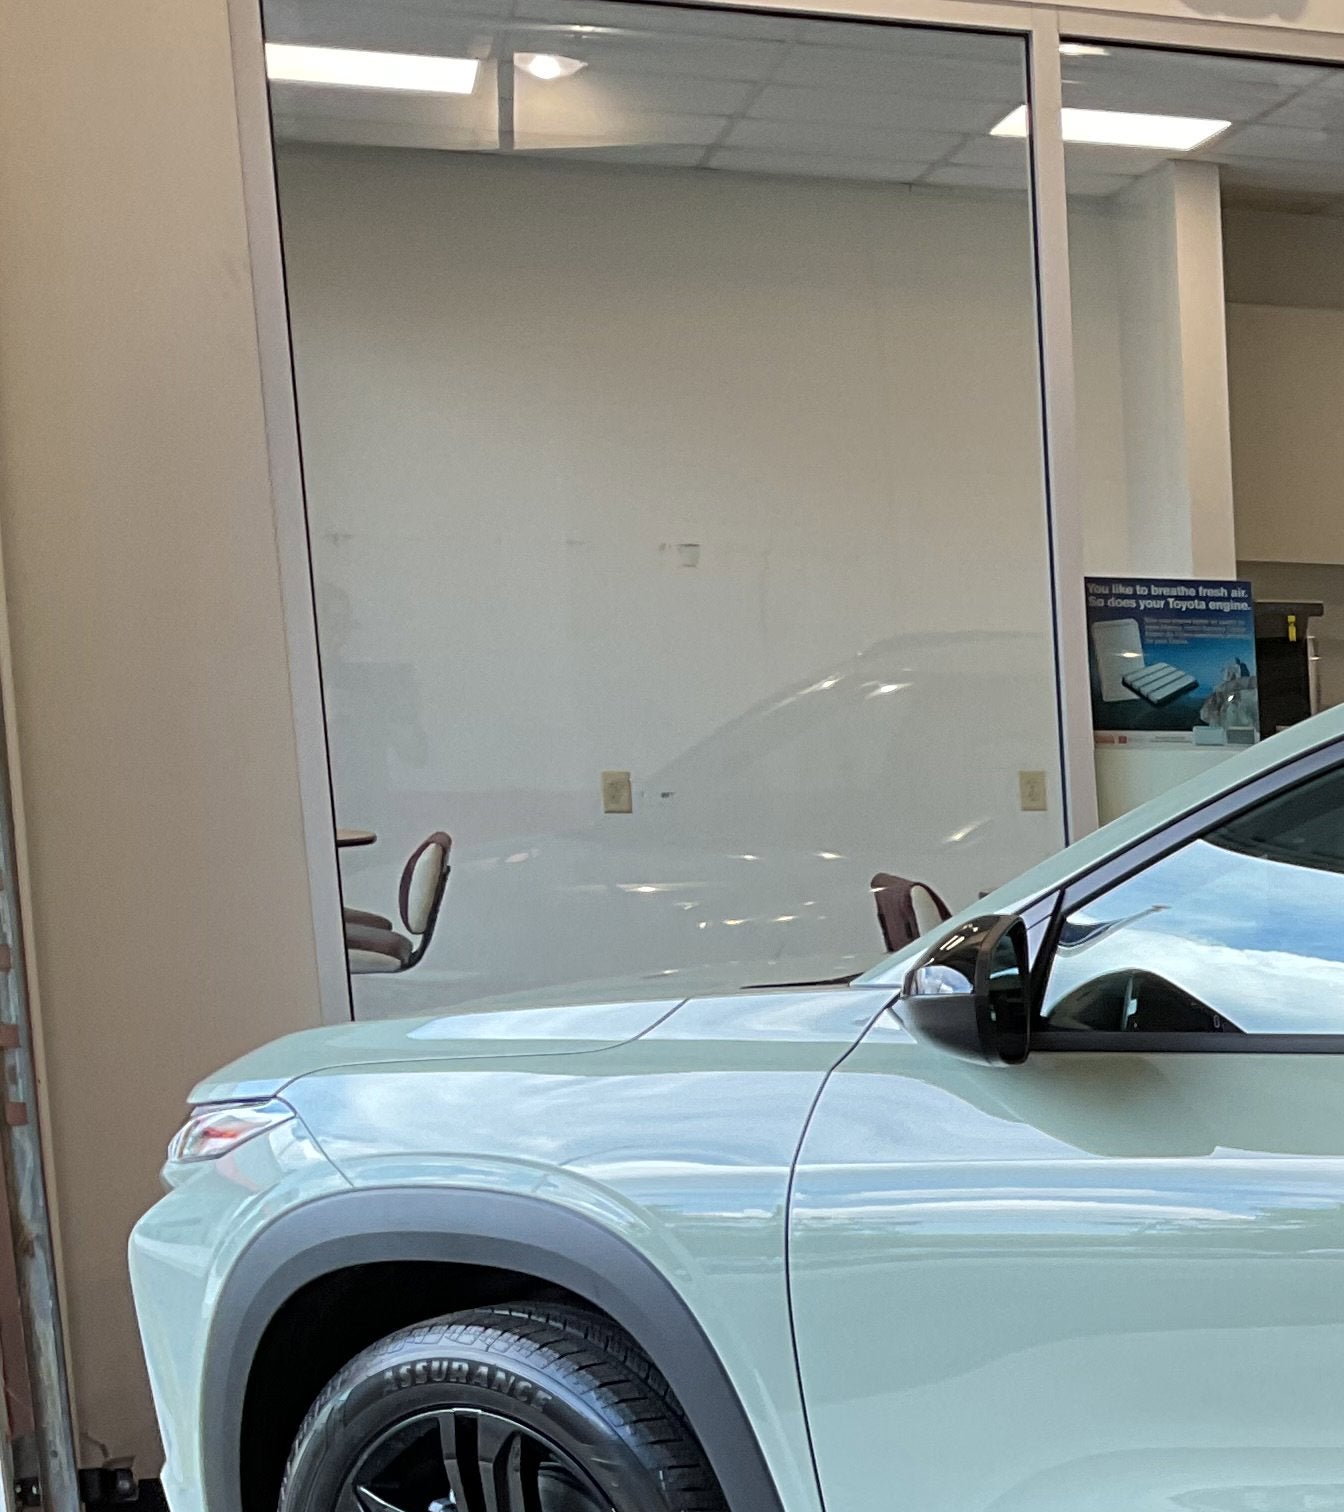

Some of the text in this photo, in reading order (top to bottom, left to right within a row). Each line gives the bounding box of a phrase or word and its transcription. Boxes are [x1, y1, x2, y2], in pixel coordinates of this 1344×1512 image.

[1087, 583, 1248, 598] You like to breathe fresh air.
[1107, 598, 1136, 609] does
[1139, 599, 1165, 610] your
[1167, 598, 1206, 612] Toyota
[1208, 601, 1252, 612] engine.
[383, 1361, 553, 1411] ASSURANCE
